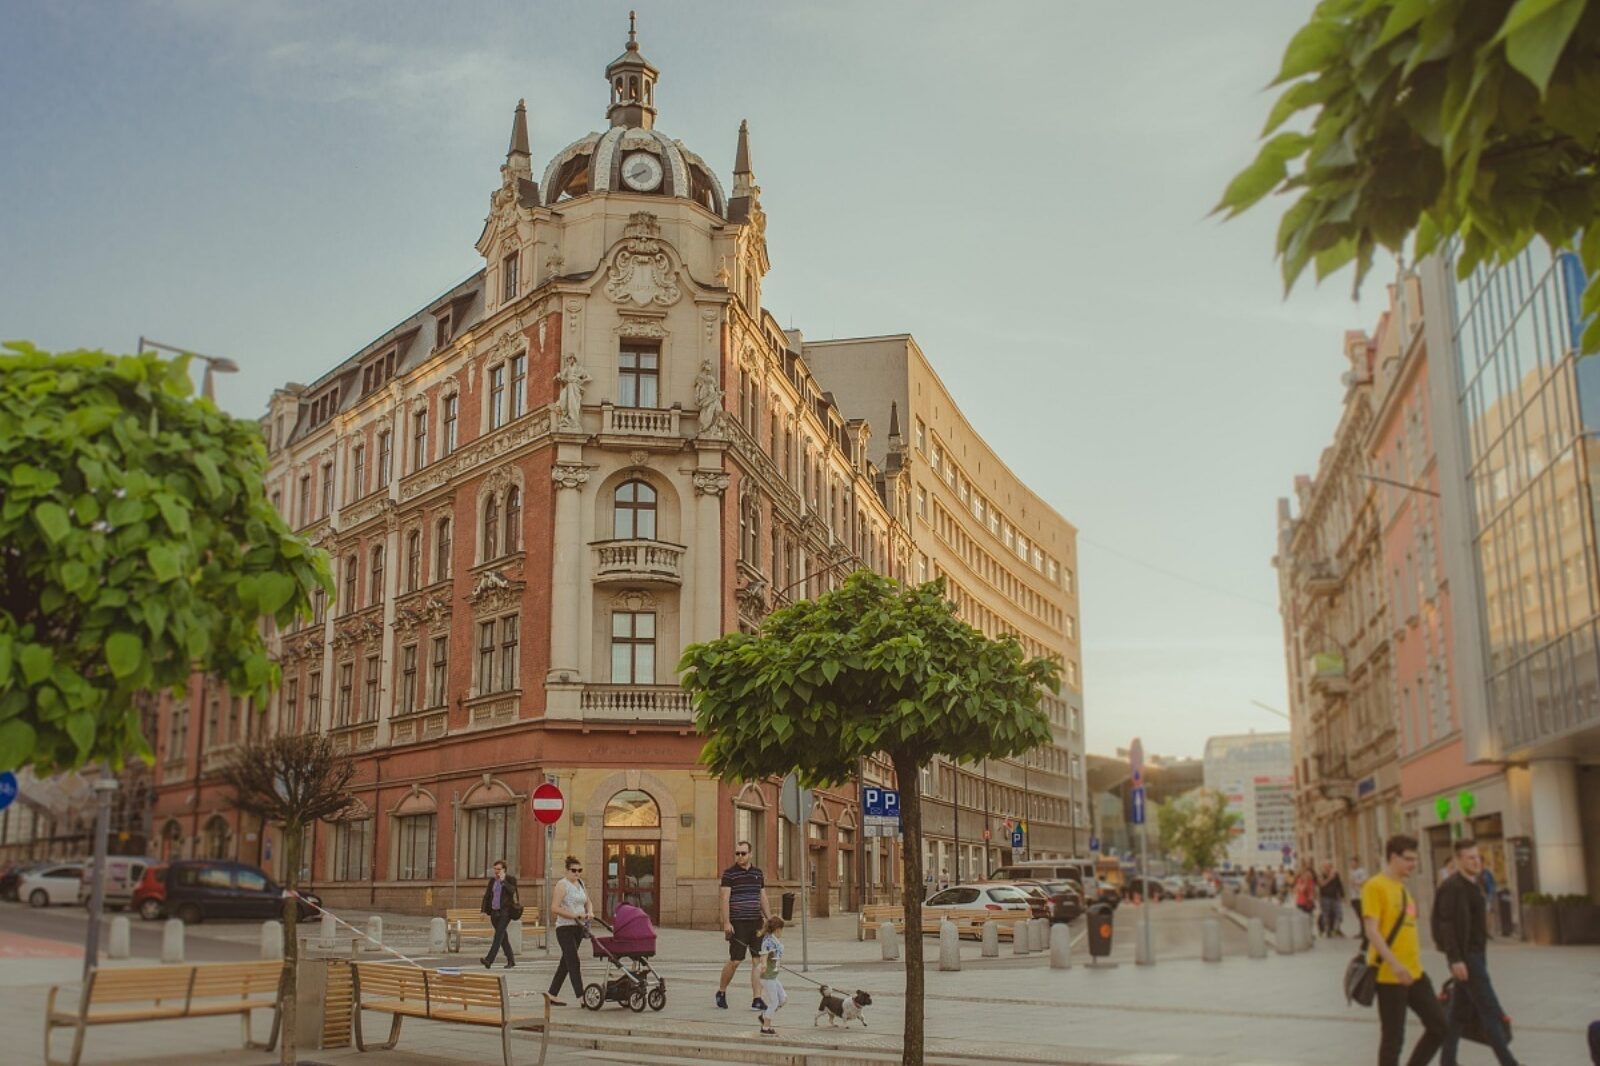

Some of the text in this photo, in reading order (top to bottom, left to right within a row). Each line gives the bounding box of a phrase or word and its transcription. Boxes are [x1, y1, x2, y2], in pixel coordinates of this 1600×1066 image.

[866, 789, 878, 808] P
[884, 793, 896, 810] P
[1013, 833, 1021, 843] P
